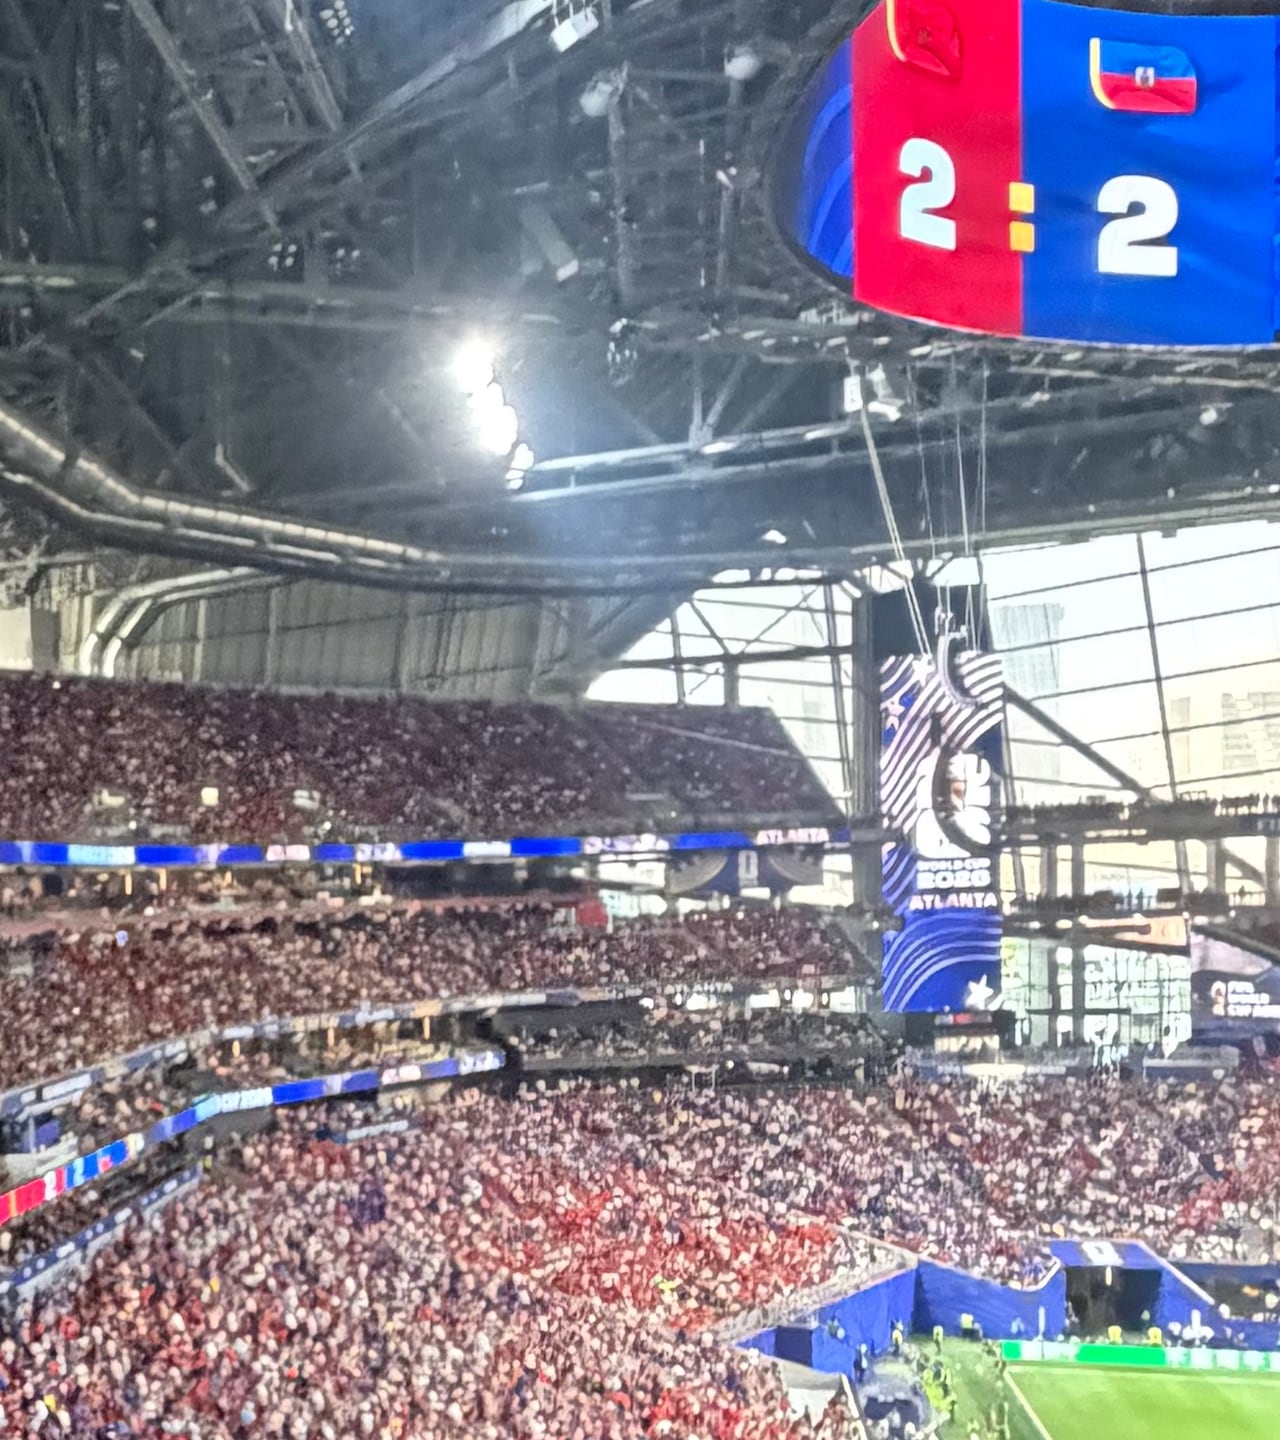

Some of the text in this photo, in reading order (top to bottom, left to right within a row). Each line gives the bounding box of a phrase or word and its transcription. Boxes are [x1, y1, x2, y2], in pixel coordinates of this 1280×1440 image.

[898, 137, 957, 251] 2
[1097, 174, 1179, 277] 2
[756, 828, 829, 846] ATLANTA
[909, 892, 997, 911] ATLANTA
